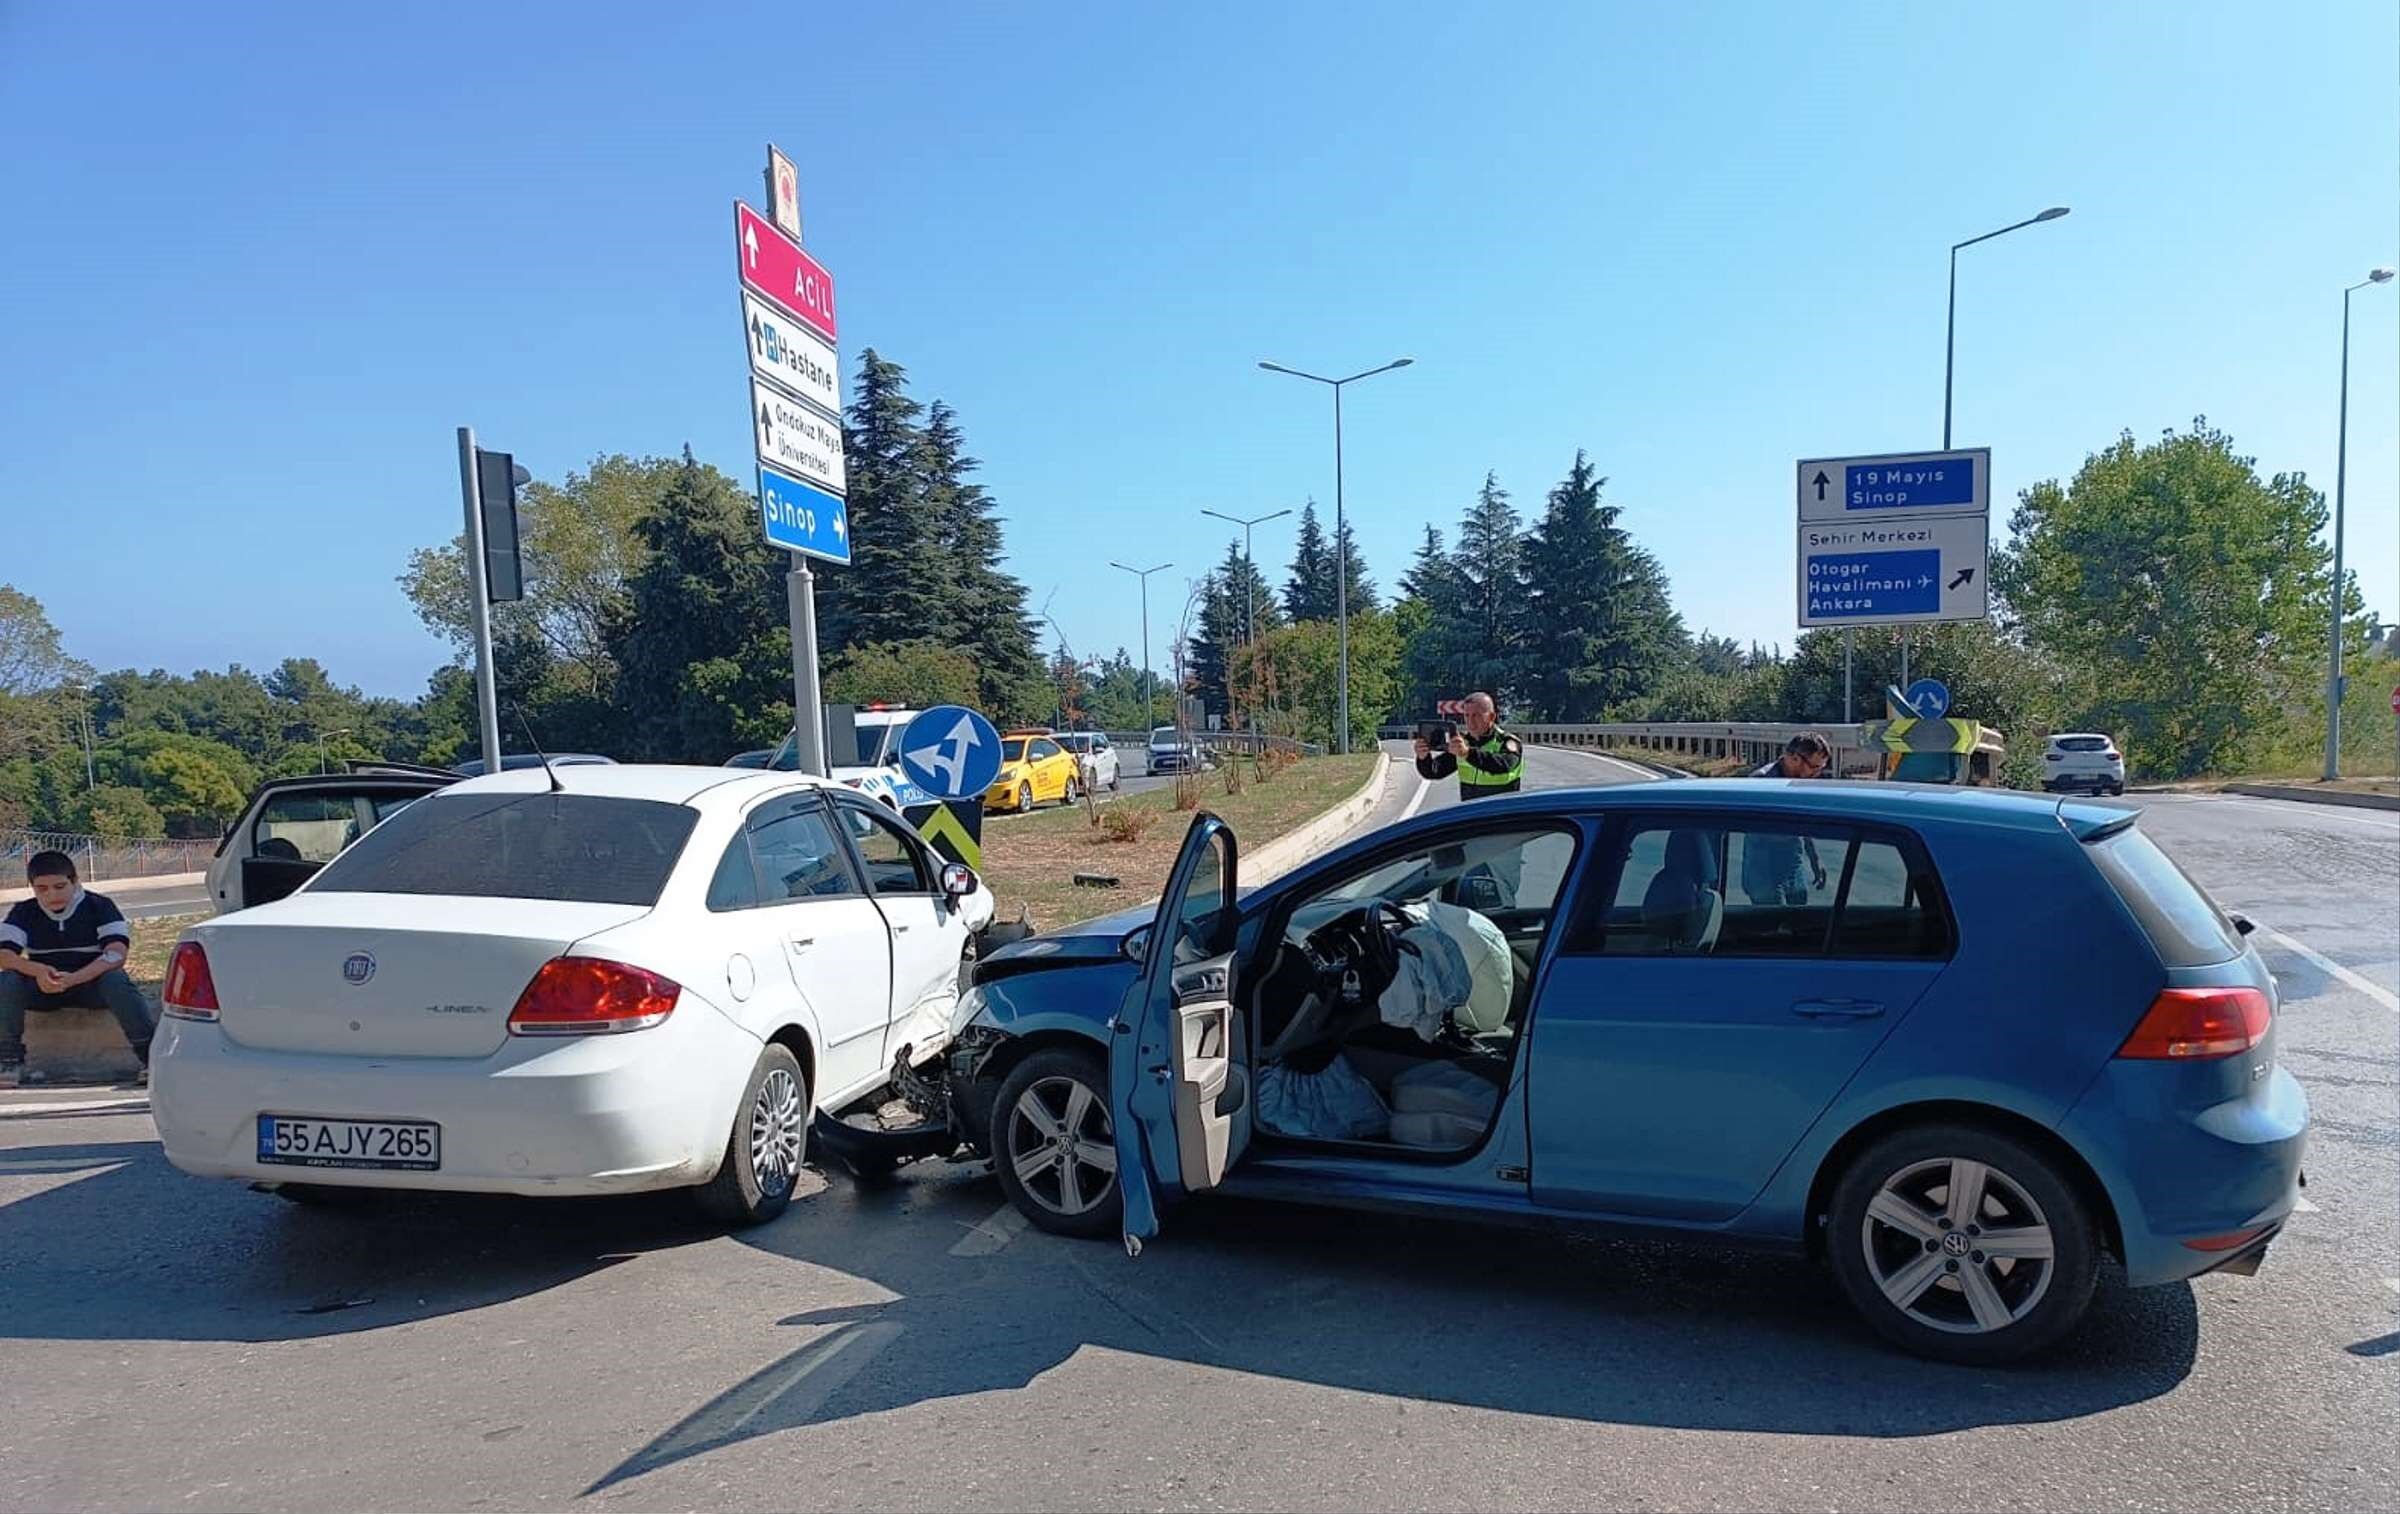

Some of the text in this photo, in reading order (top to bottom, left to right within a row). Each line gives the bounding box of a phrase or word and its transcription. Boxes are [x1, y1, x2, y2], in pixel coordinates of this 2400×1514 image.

[795, 266, 831, 320] ACİL
[778, 334, 832, 392] Hastane
[1855, 470, 1945, 486] 19 Mayıs
[1852, 491, 1908, 504] Sinop
[767, 489, 816, 540] Sinop
[1862, 529, 1932, 543] Merkezi
[1809, 563, 1870, 577] Otogar
[1809, 578, 1912, 593] Havalimanı
[1810, 598, 1872, 611] Ankara
[275, 1123, 432, 1157] 55 AJY 265
